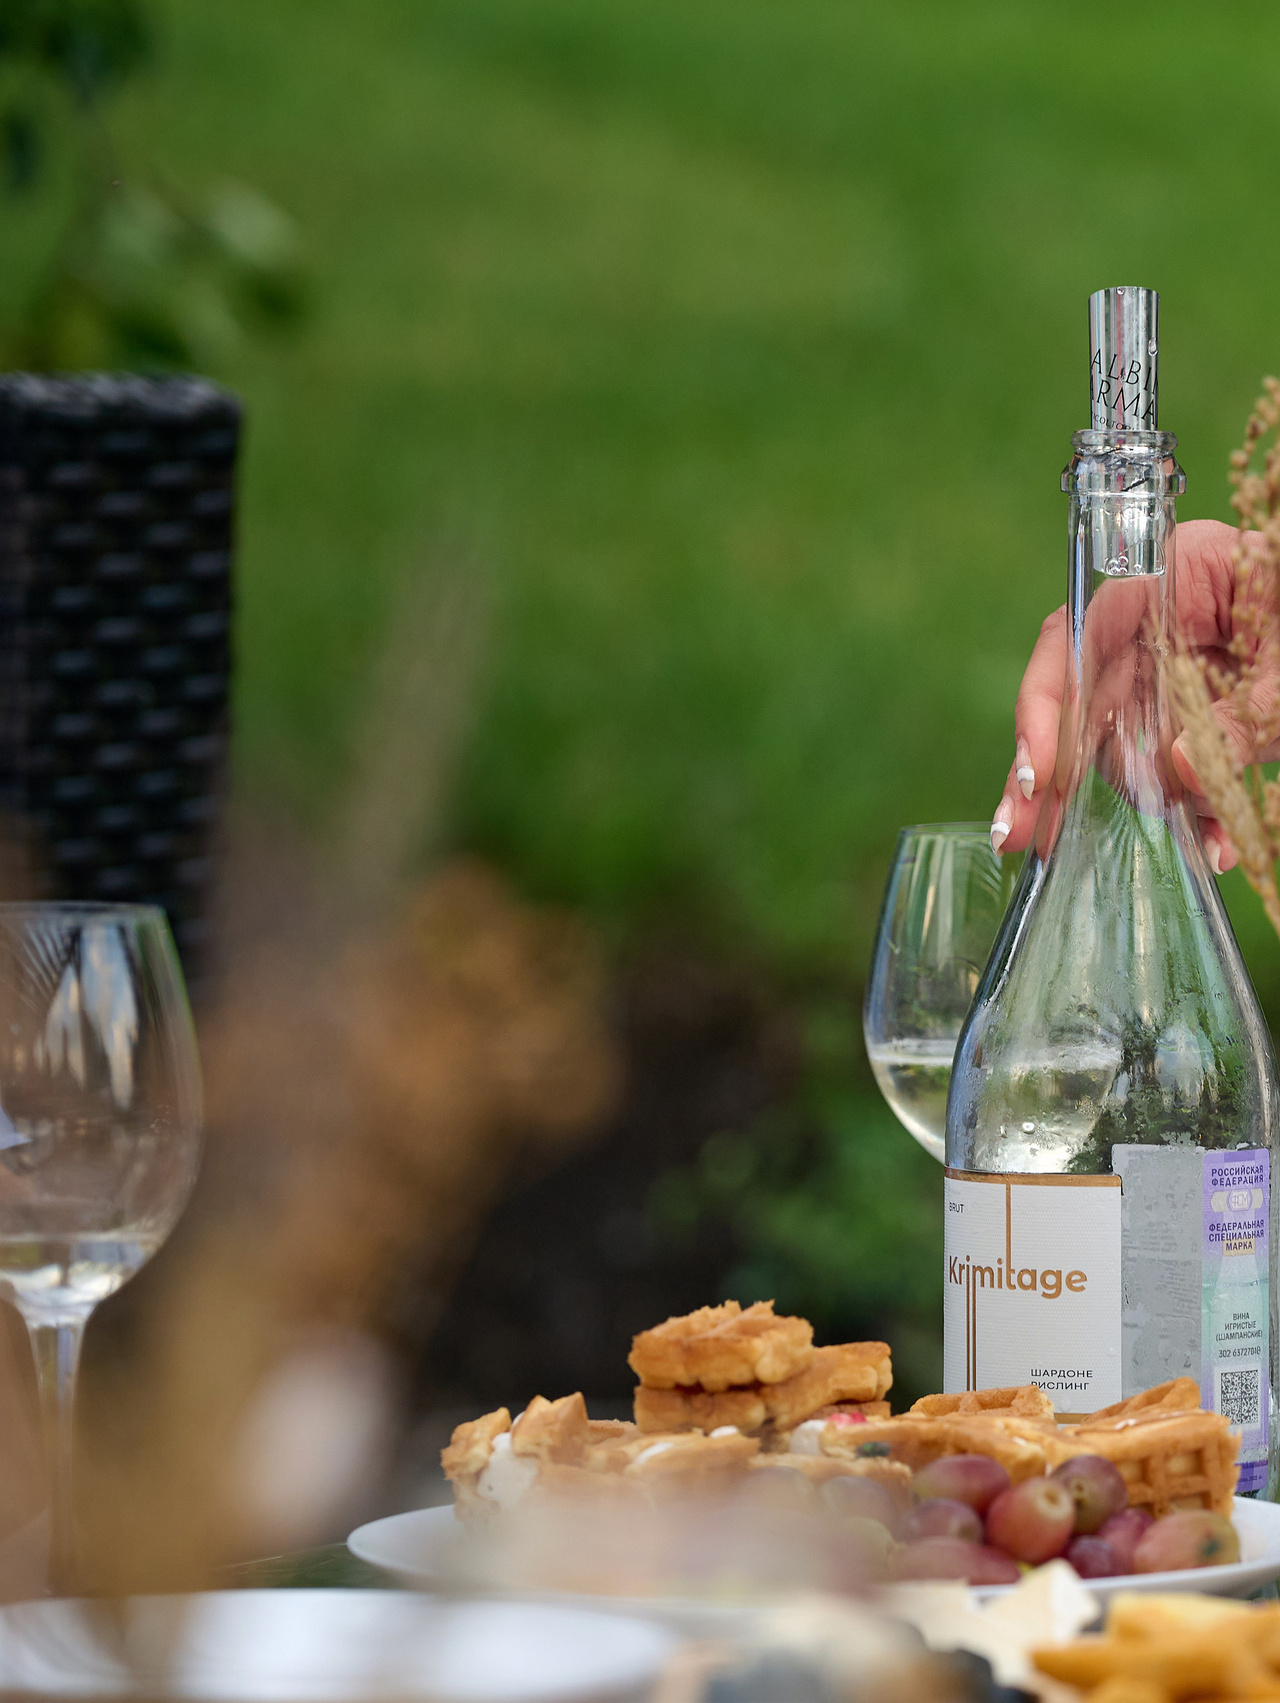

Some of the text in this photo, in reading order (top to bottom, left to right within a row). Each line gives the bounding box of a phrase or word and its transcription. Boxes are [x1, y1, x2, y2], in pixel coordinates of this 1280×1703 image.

[1211, 1165, 1264, 1177] РОССИЙСКАЯ
[1211, 1174, 1264, 1187] ФЕДЕРАЦИЯ
[949, 1202, 964, 1213] BRUT
[1209, 1219, 1265, 1232] ФЕДЕРАЛЬНАЯ
[1208, 1229, 1265, 1242] СПЕЦИАЛЬНАЯ
[1225, 1241, 1253, 1251] МАРКА
[949, 1255, 1088, 1300] Krimitage
[1224, 1321, 1257, 1330] ИГРИСТЫЕ
[1218, 1349, 1231, 1358] 302
[1031, 1369, 1093, 1378] ШАРДОНЕ
